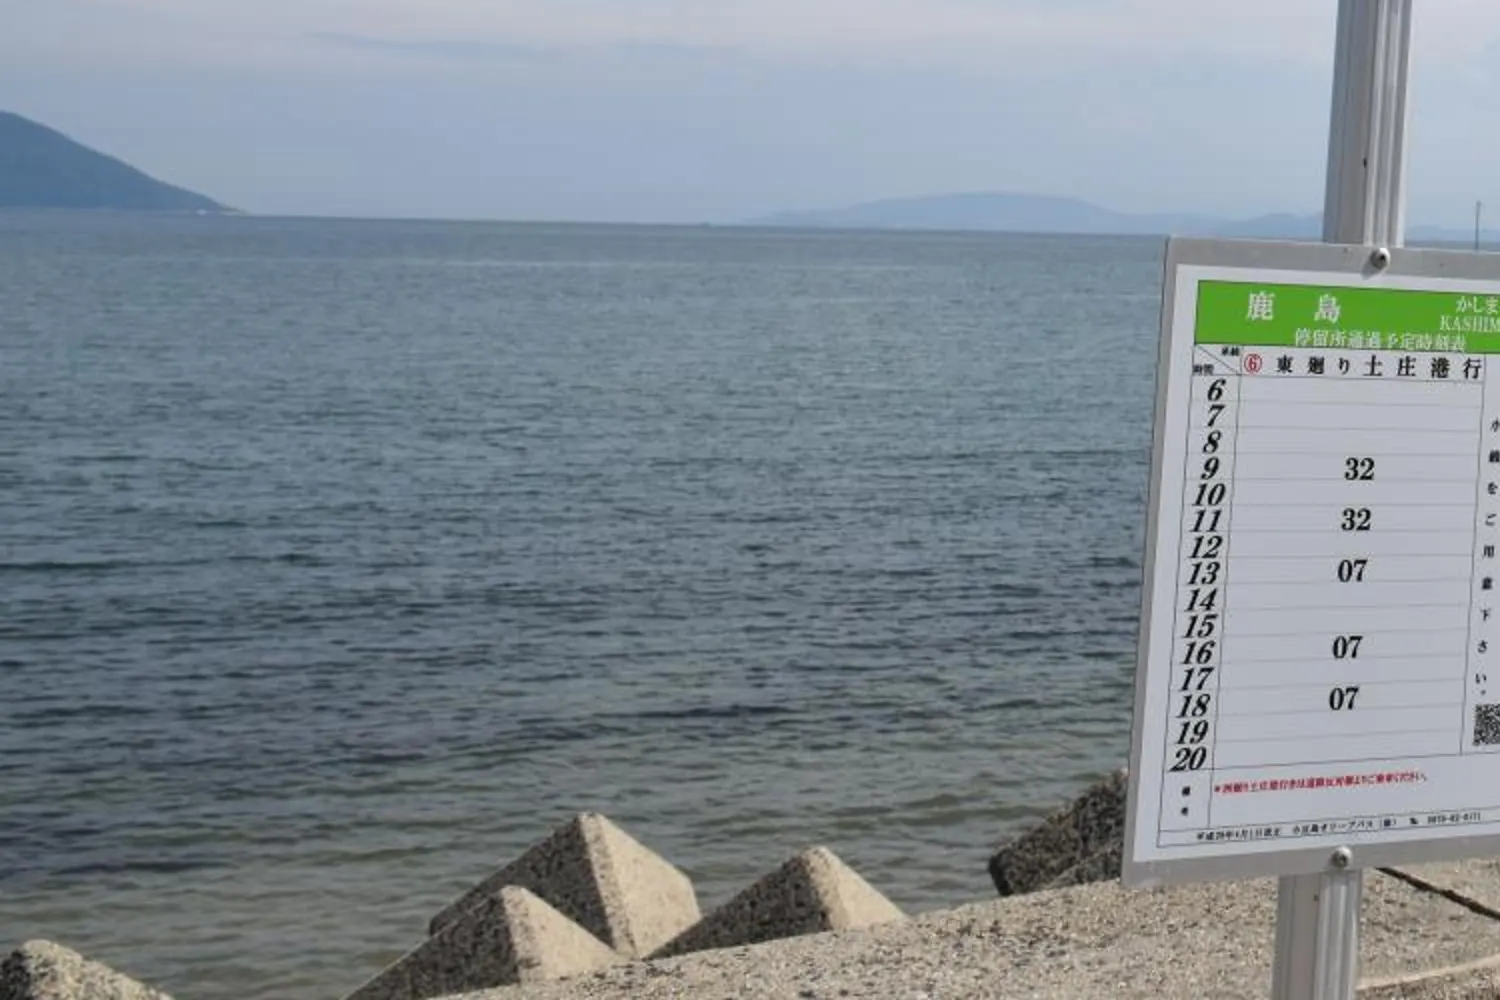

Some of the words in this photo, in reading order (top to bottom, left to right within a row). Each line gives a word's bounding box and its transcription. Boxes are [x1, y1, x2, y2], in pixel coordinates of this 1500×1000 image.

[1207, 379, 1226, 401] 6
[1207, 404, 1226, 427] 7
[1203, 430, 1222, 454] 8
[1201, 456, 1220, 480] 9
[1344, 457, 1375, 481] 32
[1192, 483, 1226, 506] 10
[1189, 509, 1222, 532] 11
[1341, 508, 1371, 531] 32
[1188, 535, 1223, 559] 12
[1187, 562, 1220, 585] 13
[1337, 559, 1368, 583] 07
[1184, 588, 1218, 612] 14
[1182, 614, 1218, 638] 15
[1181, 641, 1216, 664] 16
[1332, 635, 1363, 659] 07
[1179, 667, 1214, 691] 17
[1177, 693, 1211, 718] 18
[1328, 686, 1360, 711] 07
[1175, 720, 1209, 745] 19
[1168, 747, 1207, 772] 20
